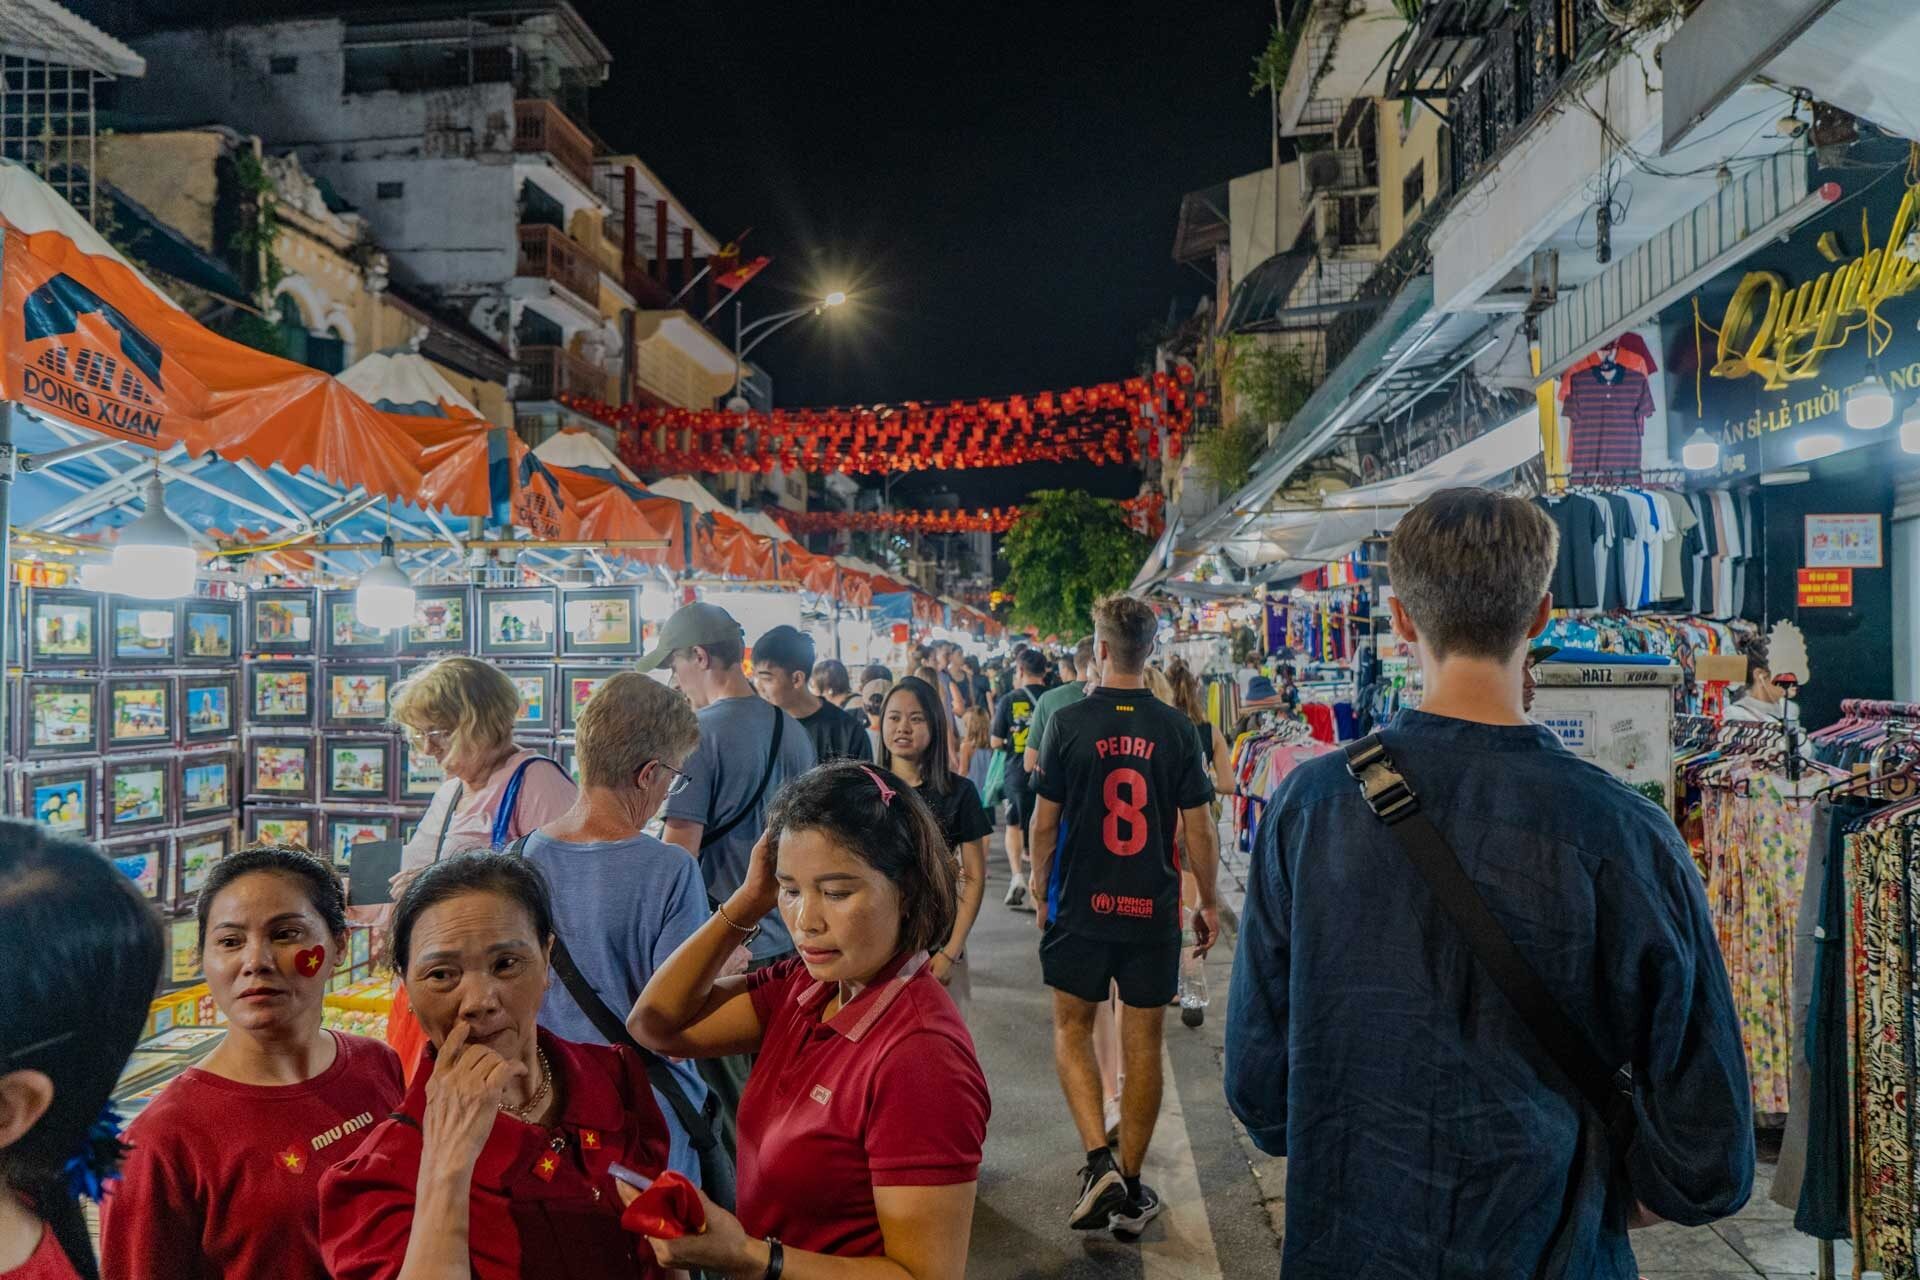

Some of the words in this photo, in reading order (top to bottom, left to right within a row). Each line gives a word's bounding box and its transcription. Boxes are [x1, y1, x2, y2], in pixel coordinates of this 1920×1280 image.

[24, 368, 90, 416] DONG
[97, 399, 161, 438] XUAN
[1095, 736, 1156, 759] PEDRI
[1103, 768, 1148, 856] 8
[1117, 896, 1153, 907] UNHCR
[1117, 905, 1153, 915] ACNUR
[311, 1127, 342, 1151] MIU
[342, 1111, 374, 1135] MIU
